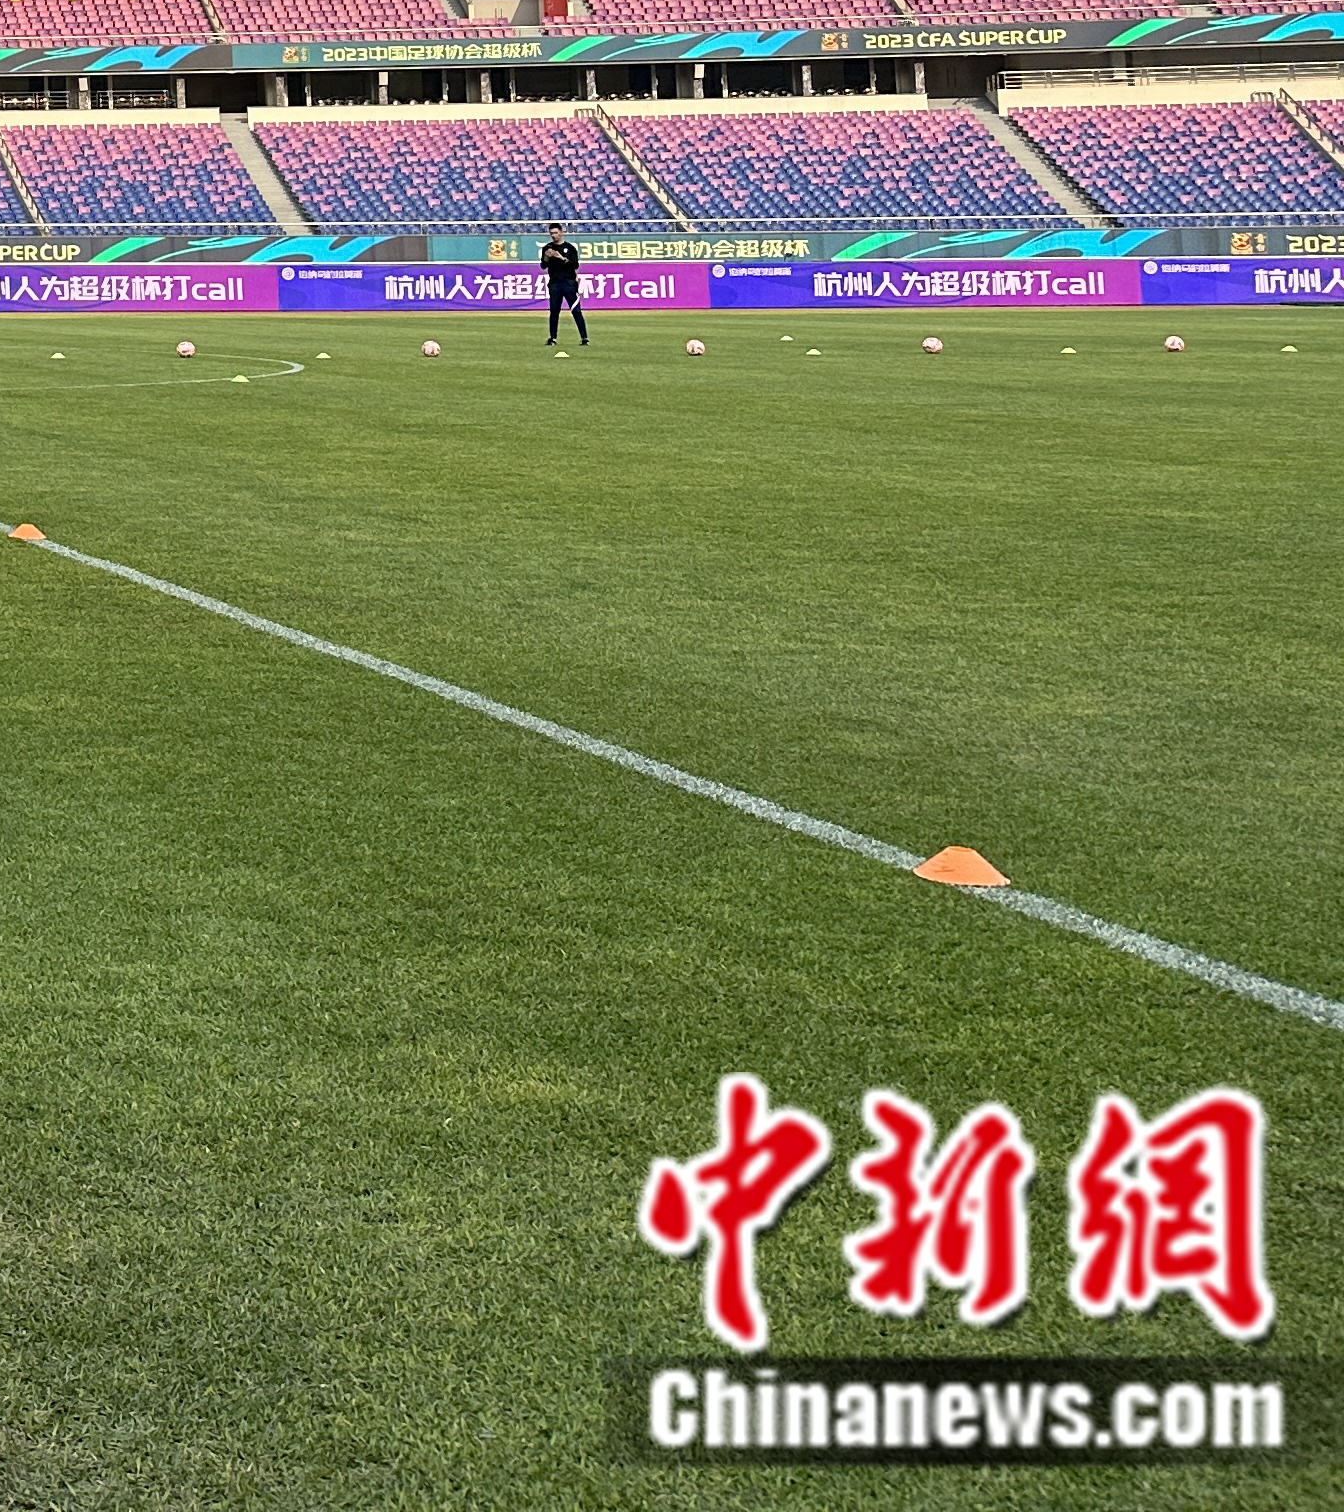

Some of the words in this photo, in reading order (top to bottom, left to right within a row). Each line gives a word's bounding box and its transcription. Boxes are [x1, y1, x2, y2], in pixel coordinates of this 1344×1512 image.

[863, 32, 914, 49] 2023
[917, 31, 957, 48] CFA
[958, 30, 1024, 47] SUPER
[1025, 29, 1067, 45] CUP
[322, 42, 542, 62] 2023中国足球协会超级杯
[39, 243, 81, 261] CUP
[813, 270, 1105, 297] 杭州人为超级杯打call
